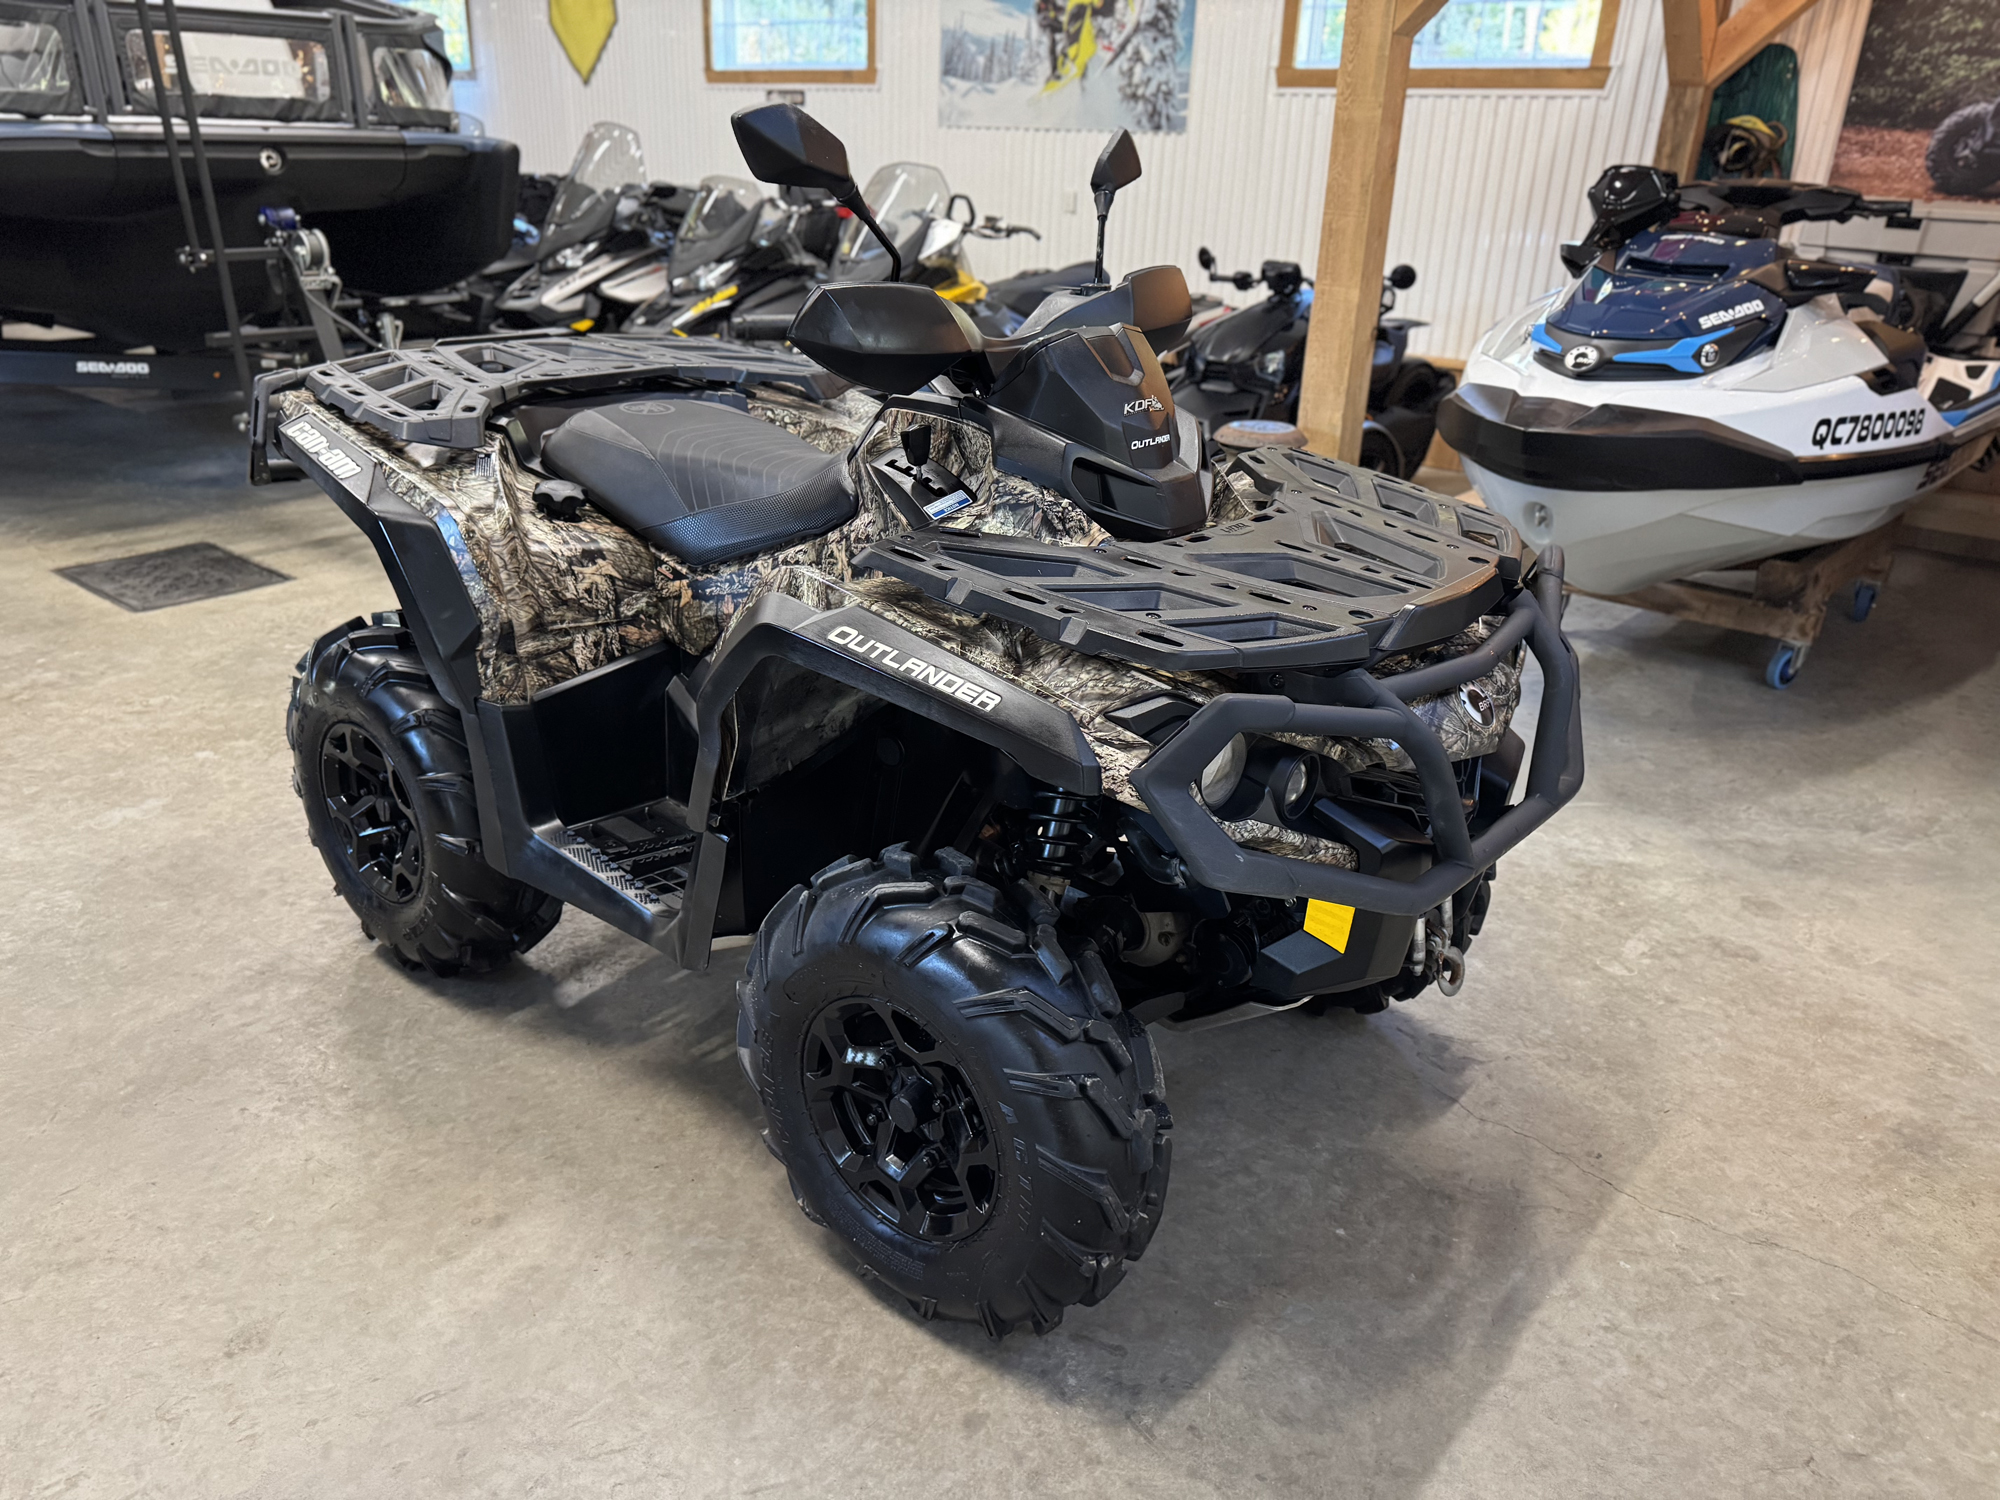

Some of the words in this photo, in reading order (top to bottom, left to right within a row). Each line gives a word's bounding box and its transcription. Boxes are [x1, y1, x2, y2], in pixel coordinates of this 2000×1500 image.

[1130, 434, 1171, 450] OUTLANDER
[1812, 408, 1926, 450] QC7800098
[827, 625, 1003, 713] OUTLANDER
